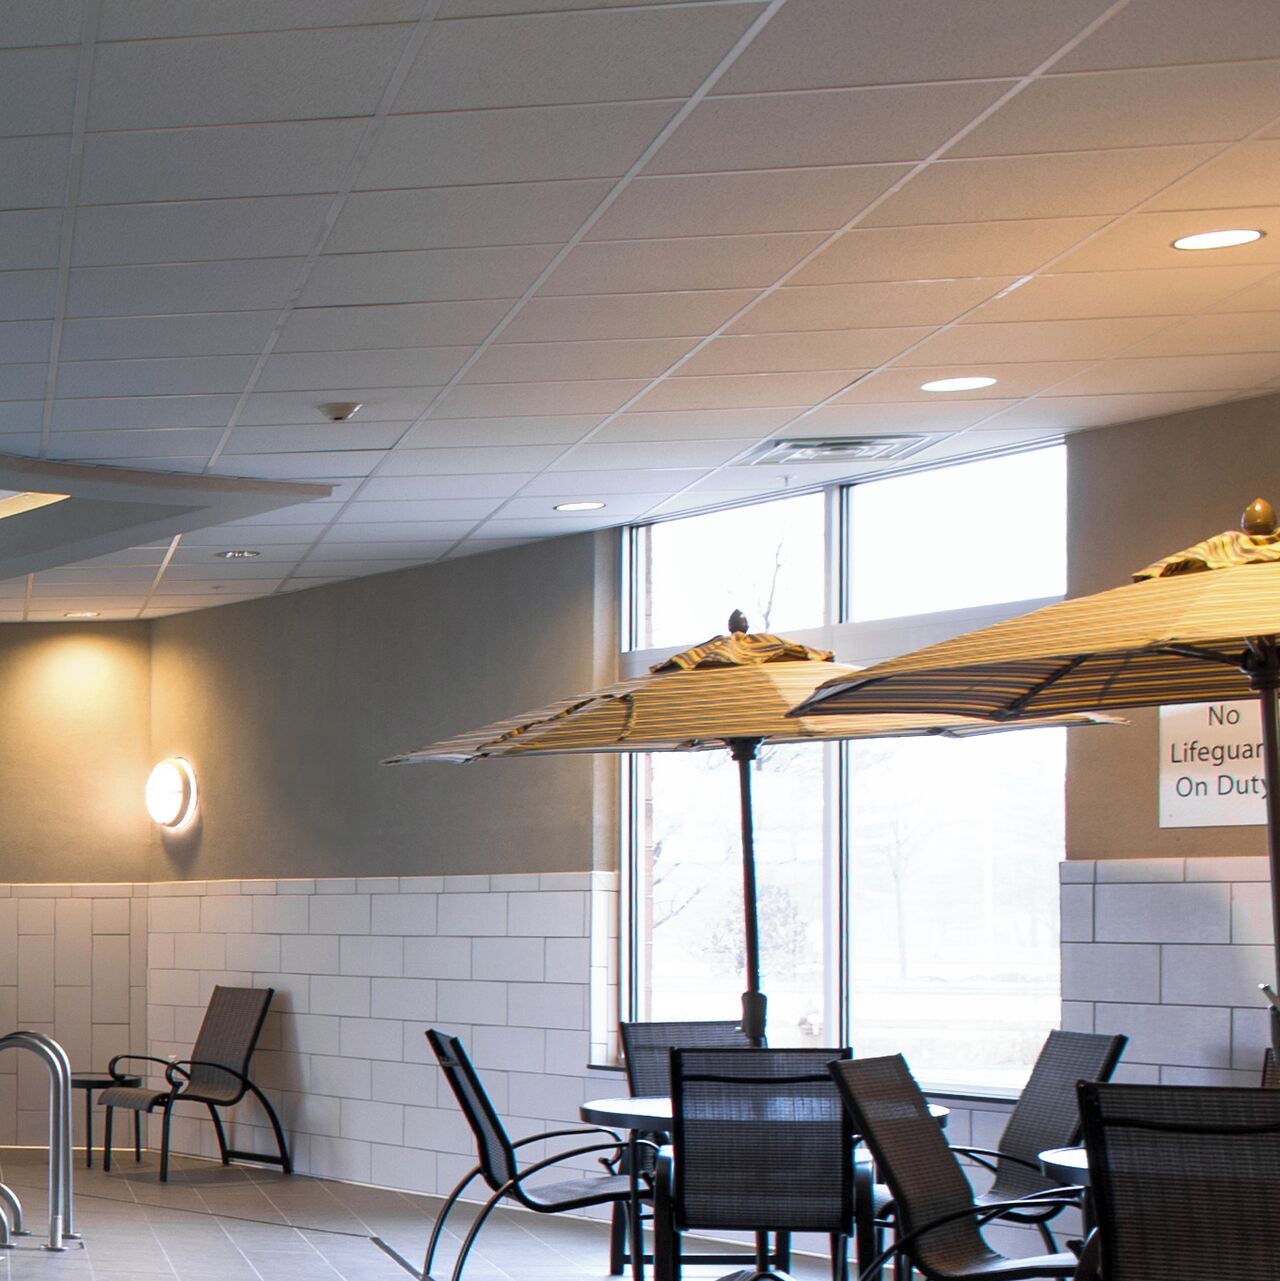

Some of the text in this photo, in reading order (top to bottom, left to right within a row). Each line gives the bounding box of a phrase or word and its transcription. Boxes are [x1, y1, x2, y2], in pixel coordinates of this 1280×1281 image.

[1208, 705, 1240, 726] No
[1171, 740, 1264, 766] Lifeguar
[1176, 775, 1268, 800] On Duty
